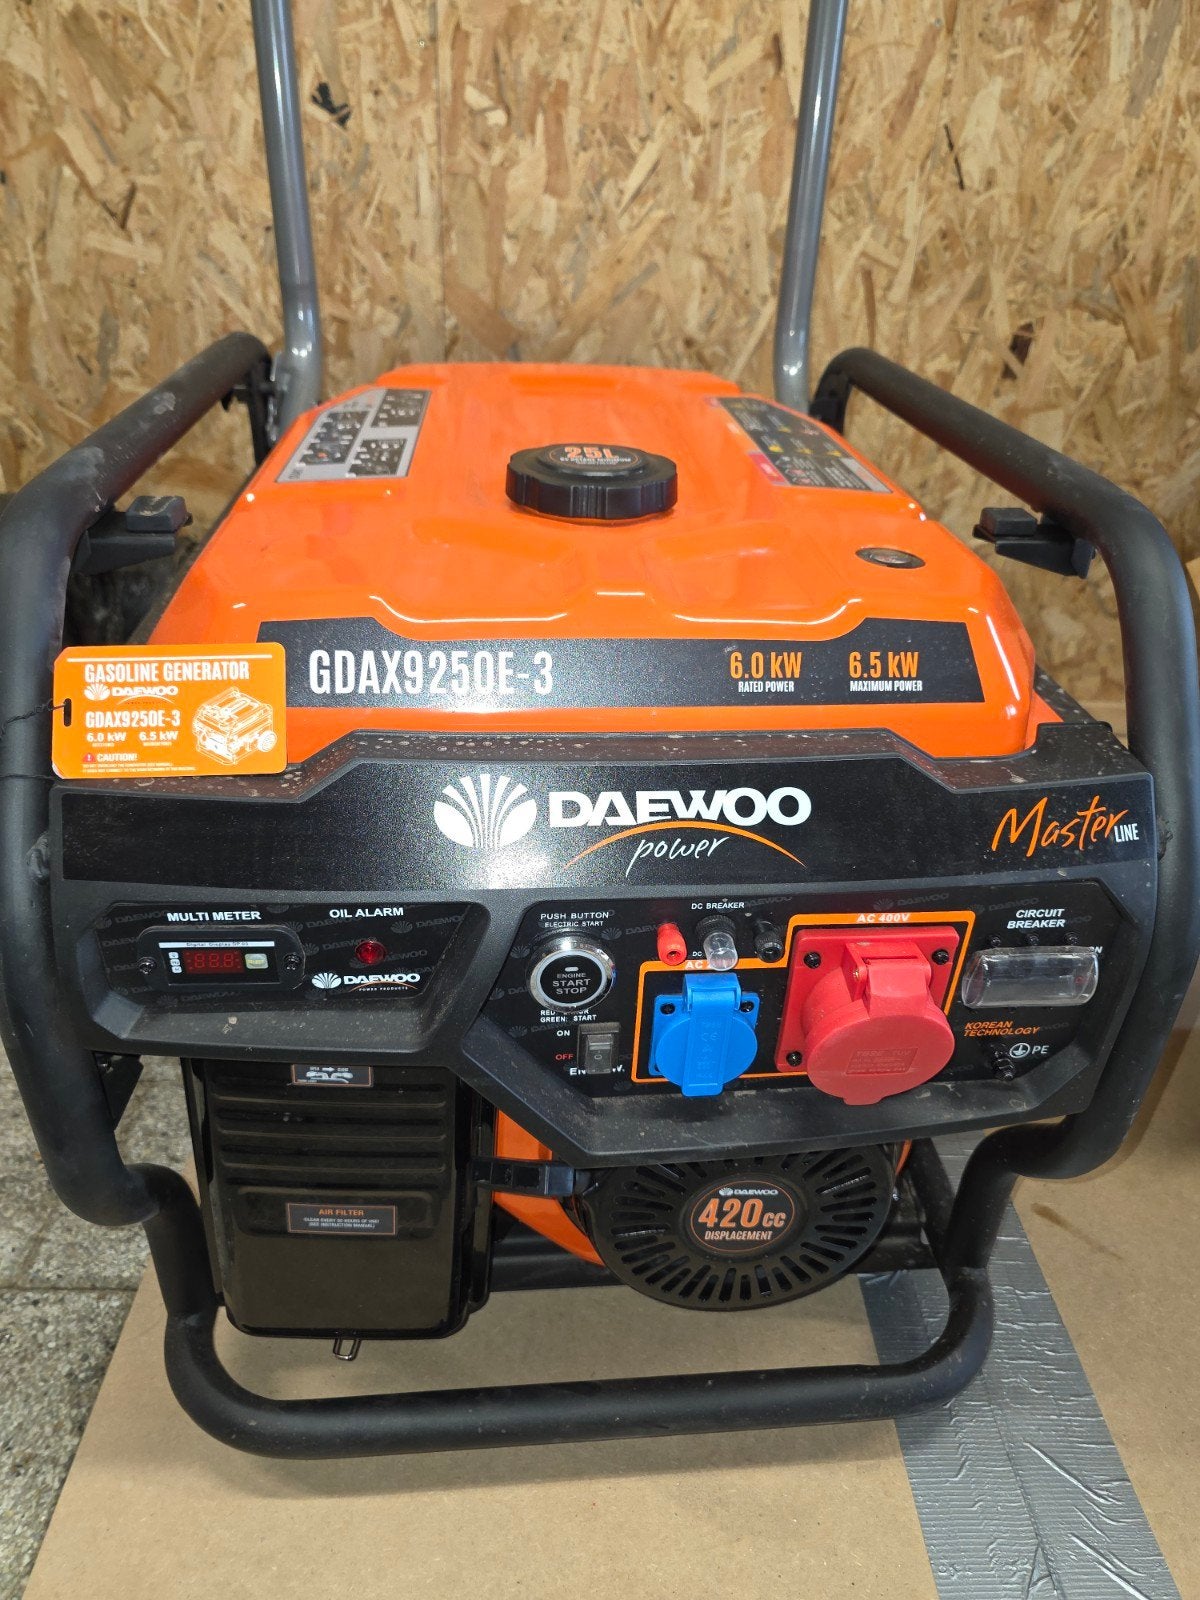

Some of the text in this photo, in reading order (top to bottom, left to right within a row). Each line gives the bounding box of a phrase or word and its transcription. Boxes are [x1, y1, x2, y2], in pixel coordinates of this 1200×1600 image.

[564, 446, 619, 458] 25L
[730, 652, 803, 679] 6.0 kW
[849, 651, 919, 678] 6.5 kW
[84, 660, 249, 683] GASOLINE GENERATOR
[309, 650, 554, 695] GDAX9250E-3
[112, 686, 179, 697] DAEWOO
[738, 681, 794, 693] RATED POWER
[850, 680, 923, 692] MAXIMUM POWER
[85, 709, 181, 728] GDAX9250E-3
[86, 732, 127, 742] 6.0 kW
[139, 731, 179, 742] 6.5 kW
[97, 753, 138, 762] CAUTION!
[549, 787, 813, 828] DAEWOO
[991, 795, 1140, 858] Master LINE
[625, 836, 730, 878] power
[706, 902, 745, 910] BREAKER
[167, 911, 262, 922] MULTI METER
[329, 907, 404, 918] OIL ALARM
[856, 913, 911, 923] AC 400V
[1016, 908, 1065, 918] CIRCUIT
[1007, 919, 1066, 929] BREAKER
[685, 962, 703, 970] AC
[344, 973, 421, 985] DAEWOO
[552, 979, 591, 987] START
[556, 987, 587, 995] STOP
[965, 1021, 1014, 1030] KOREAN
[964, 1027, 1041, 1037] TECHNOLOGY
[1031, 1045, 1050, 1055] PE
[319, 1208, 365, 1217] AIR FILTER
[704, 1230, 773, 1240] DISPLACEMENT
